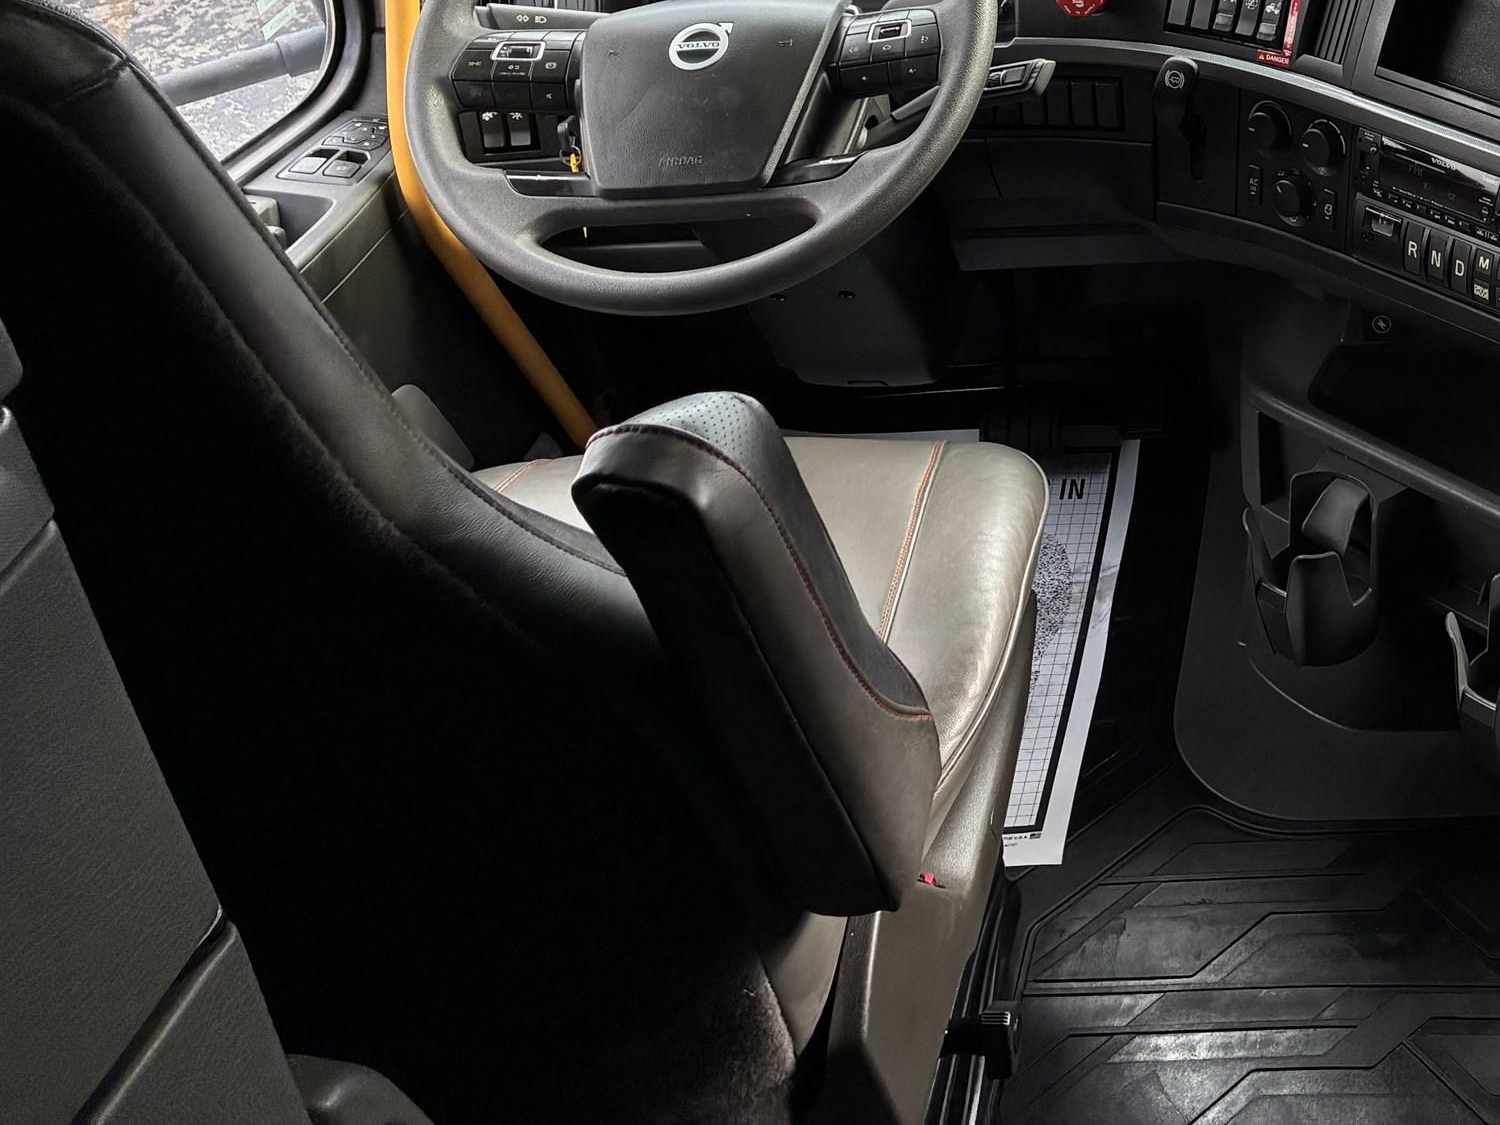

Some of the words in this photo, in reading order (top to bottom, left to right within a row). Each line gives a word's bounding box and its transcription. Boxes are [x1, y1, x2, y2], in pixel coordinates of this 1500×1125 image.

[1266, 53, 1290, 65] DANGER
[658, 155, 704, 168] AIRBAG
[1430, 157, 1457, 171] VOLVO
[1249, 177, 1258, 186] AC
[1407, 240, 1418, 259] R
[1431, 250, 1441, 268] N
[1478, 255, 1490, 271] M
[1454, 260, 1465, 277] D
[1059, 478, 1086, 500] IN
